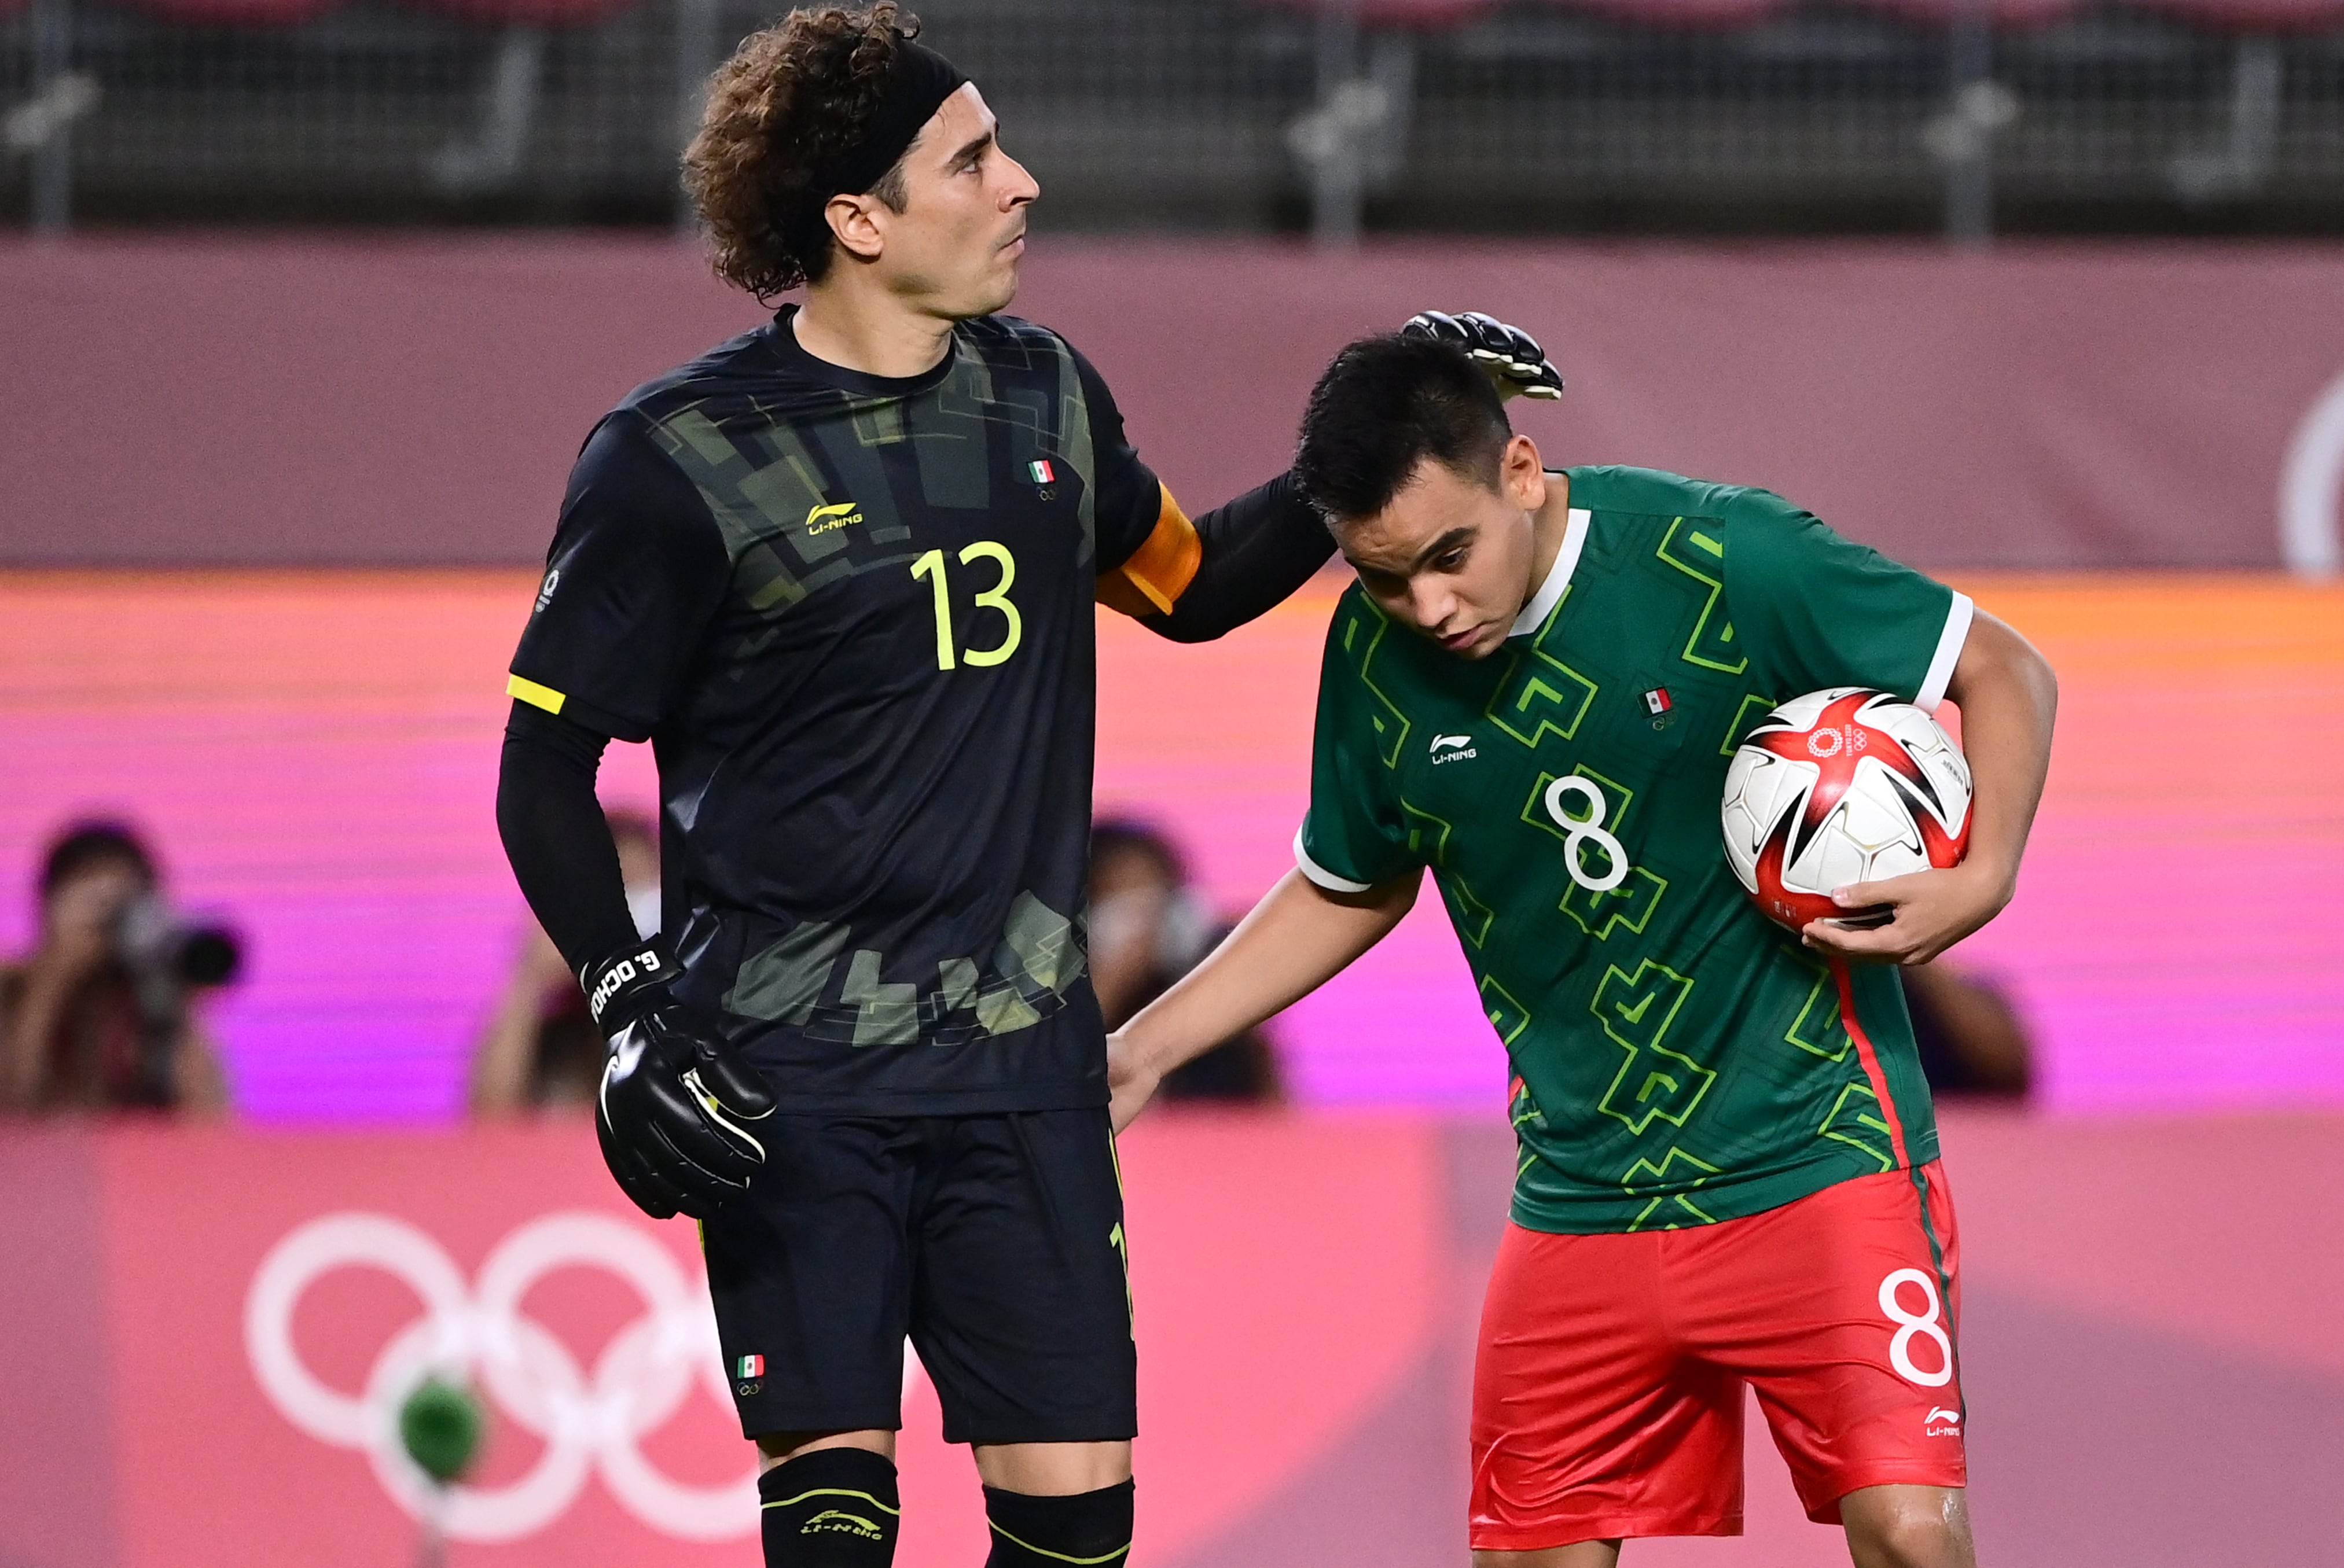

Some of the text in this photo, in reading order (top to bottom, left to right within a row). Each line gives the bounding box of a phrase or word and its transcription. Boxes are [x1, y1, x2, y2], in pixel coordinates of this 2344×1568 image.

[809, 513, 862, 536] LI-NING
[910, 540, 1022, 671] 13
[1432, 748, 1477, 765] LI-NING
[1545, 775, 1629, 891] 8
[634, 950, 661, 972] G.
[1878, 1268, 1952, 1387] 8
